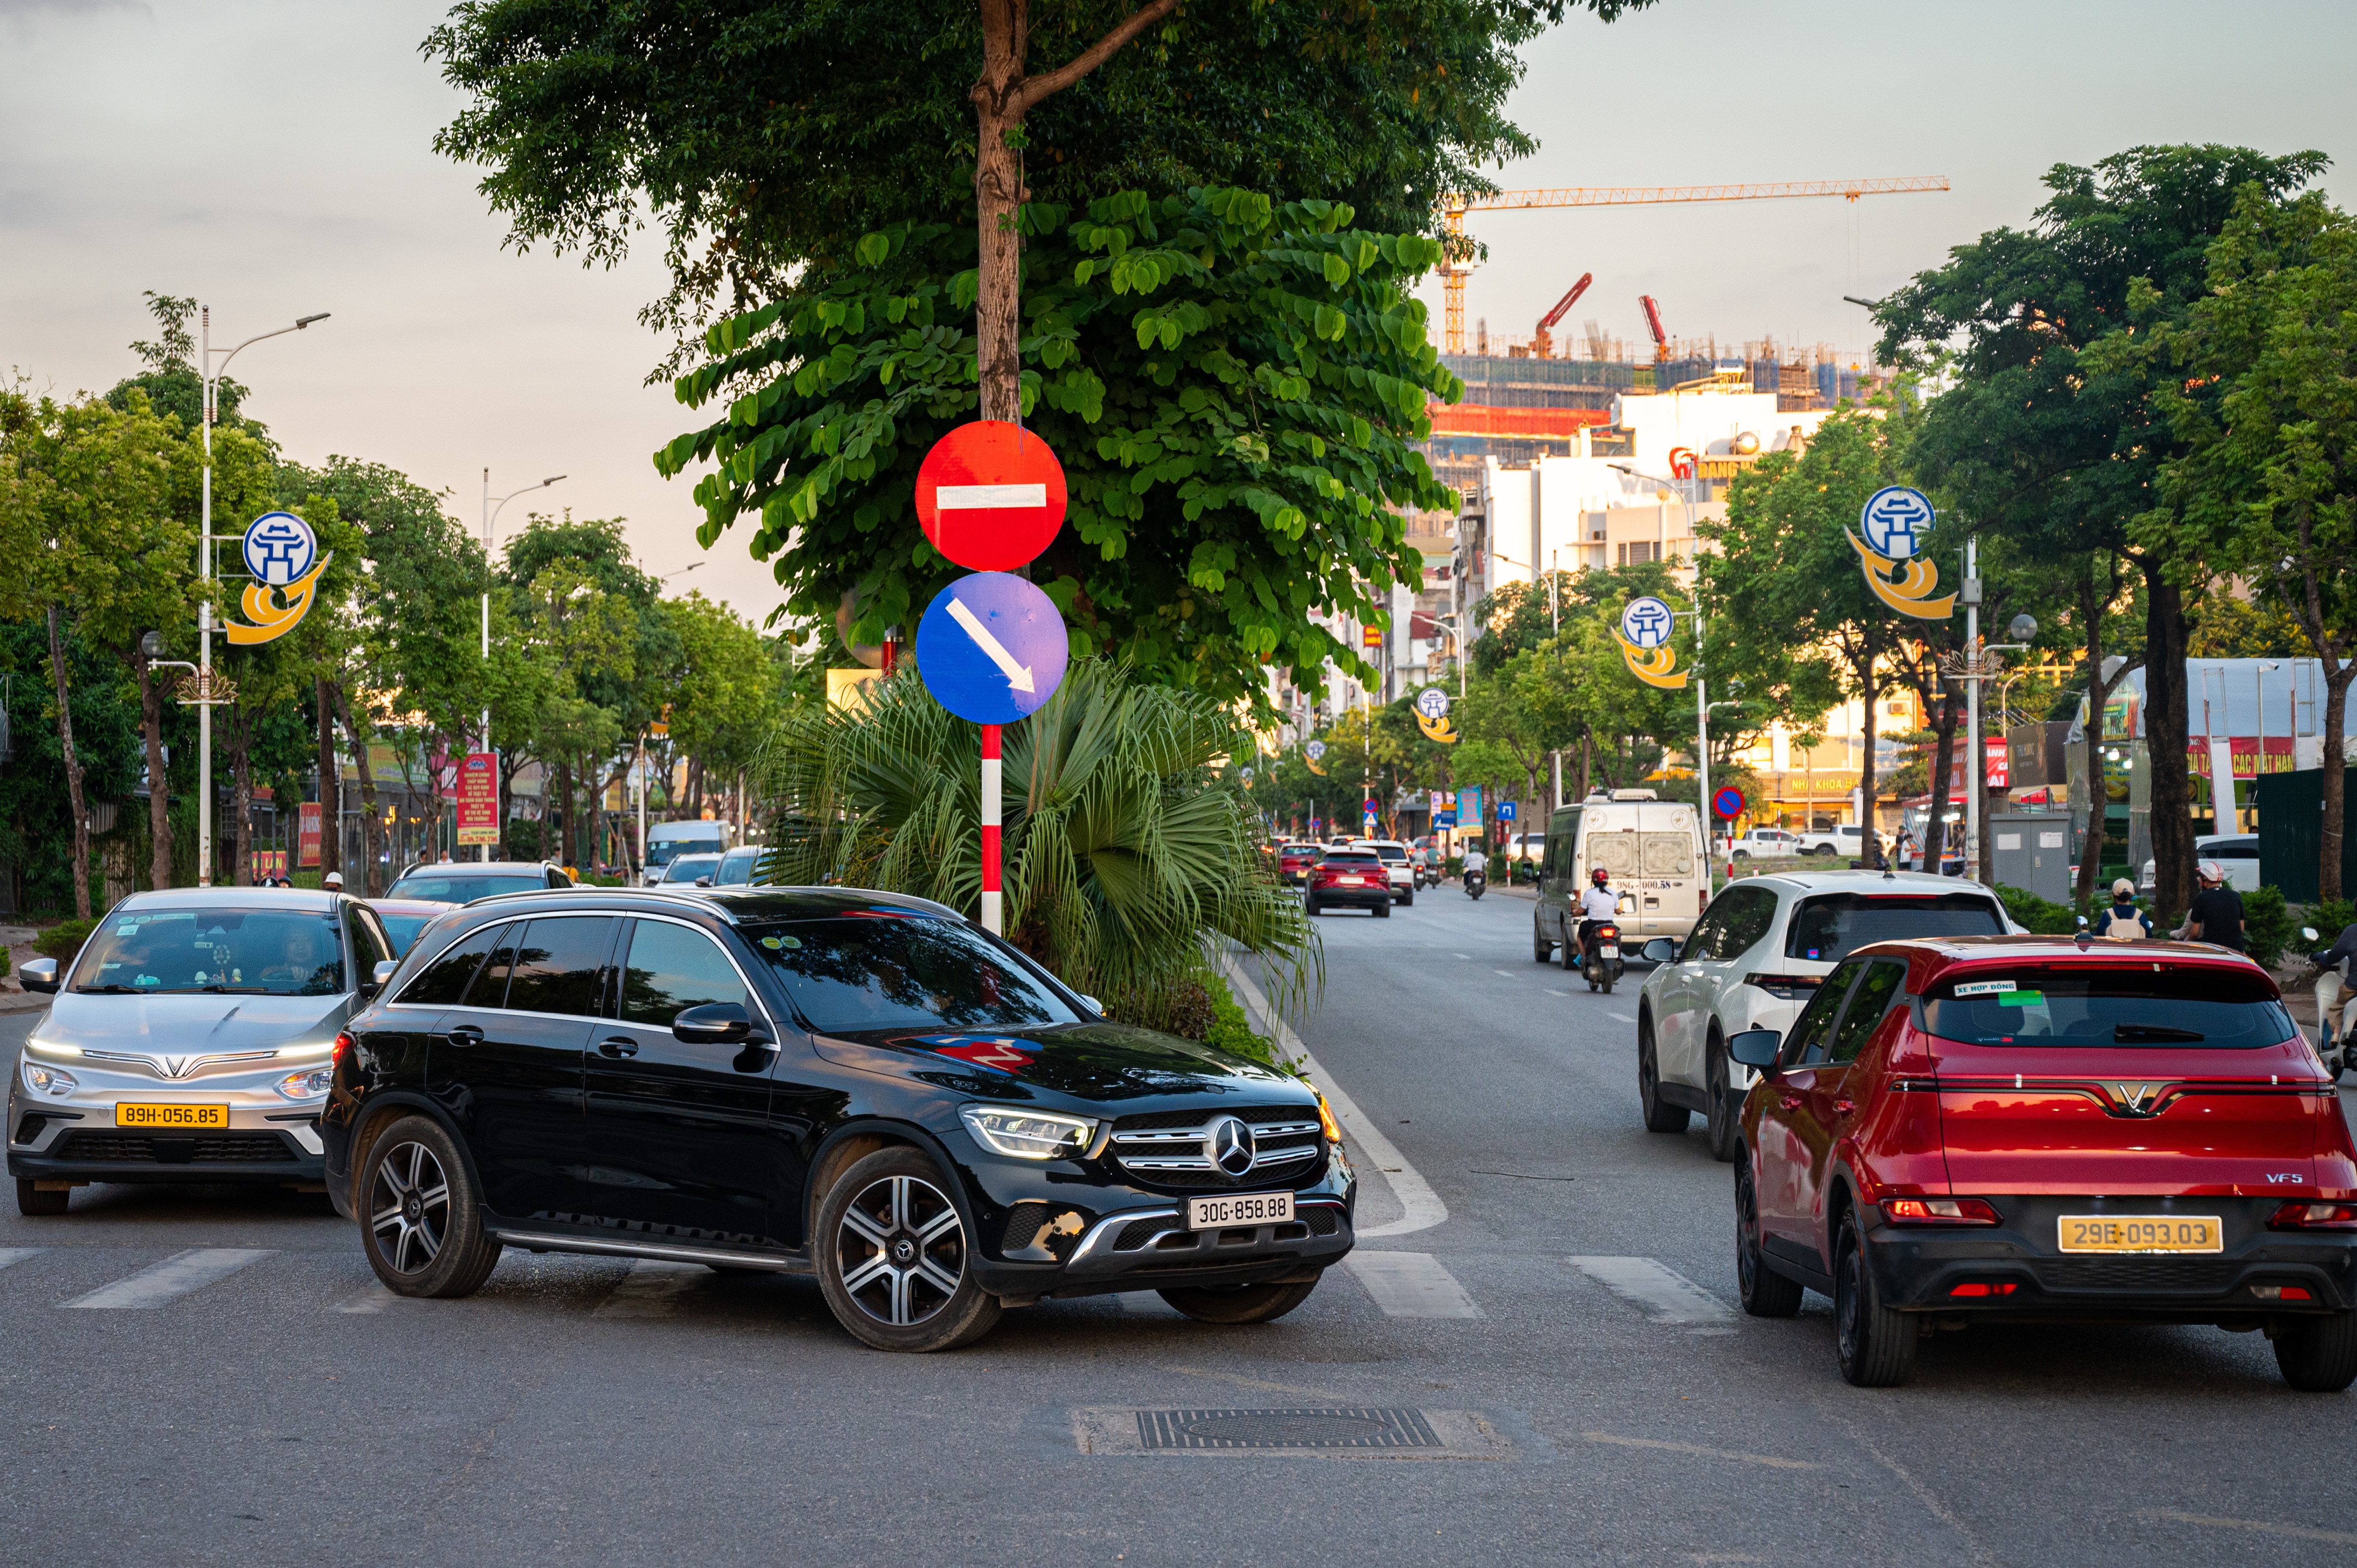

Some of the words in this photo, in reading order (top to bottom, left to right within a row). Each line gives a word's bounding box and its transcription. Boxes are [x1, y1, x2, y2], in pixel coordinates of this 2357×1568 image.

[2233, 750, 2252, 774] CÁC
[2275, 749, 2293, 772] HÀN
[1815, 779, 1842, 790] KHOA
[1617, 880, 1634, 889] 98G
[1642, 880, 1671, 889] 000.58
[126, 1107, 218, 1123] 89H-056.85
[2266, 1173, 2303, 1184] VF5
[1199, 1198, 1286, 1223] 30G-858.88
[2074, 1223, 2207, 1245] 29E-093.03
